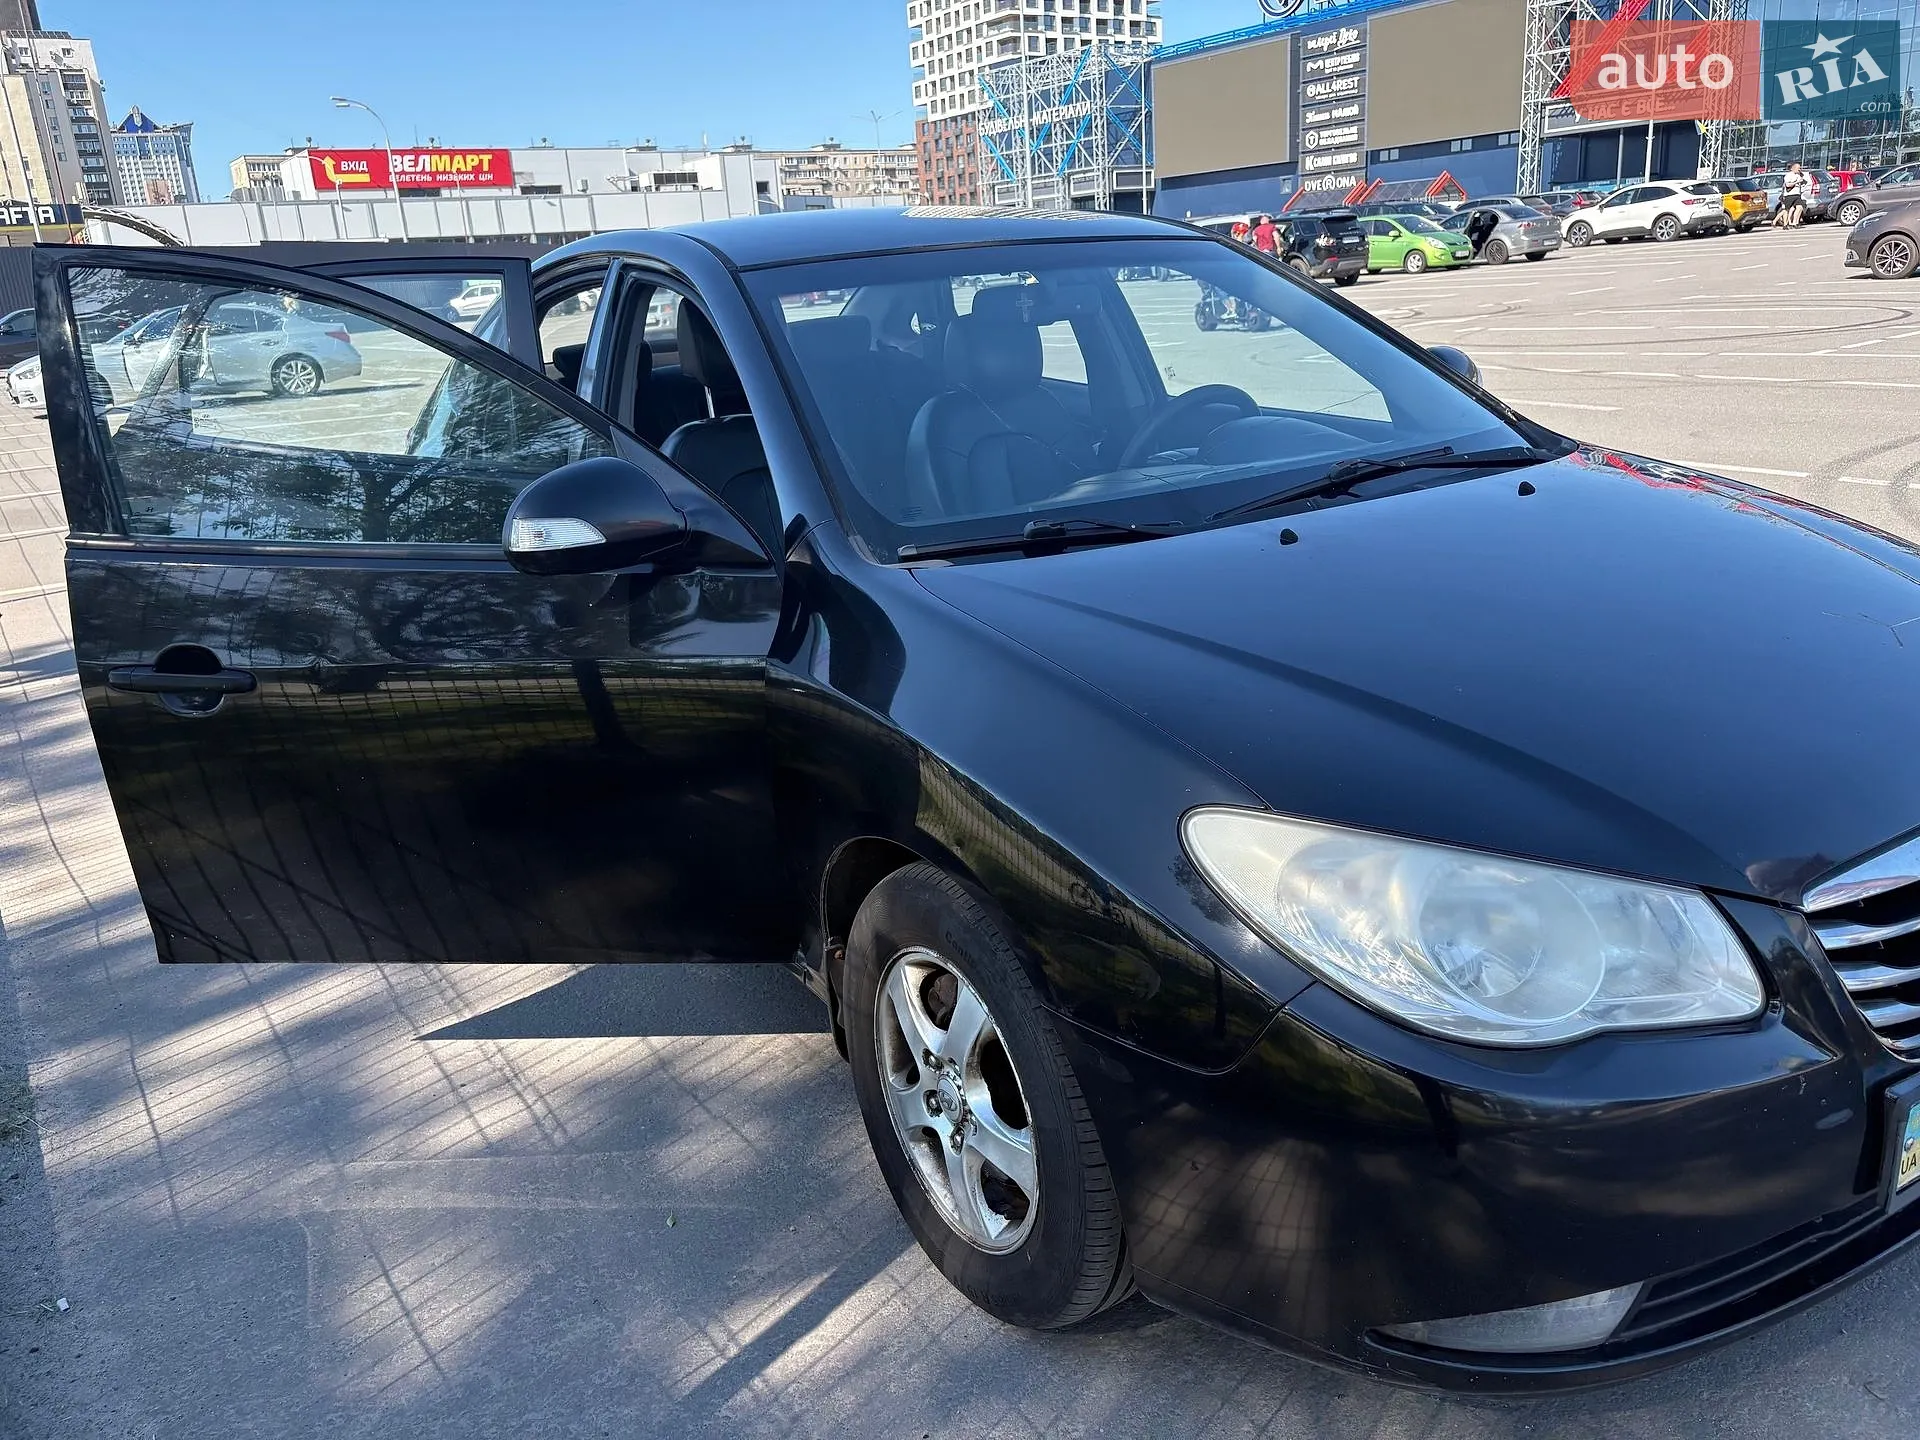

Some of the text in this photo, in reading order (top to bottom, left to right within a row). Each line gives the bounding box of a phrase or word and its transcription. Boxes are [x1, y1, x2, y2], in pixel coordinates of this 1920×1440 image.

[341, 160, 368, 172] ВХІД
[389, 154, 492, 173] ВЕЛМАРТ
[479, 173, 493, 182] ЦІН
[1901, 1152, 1917, 1175] UA
